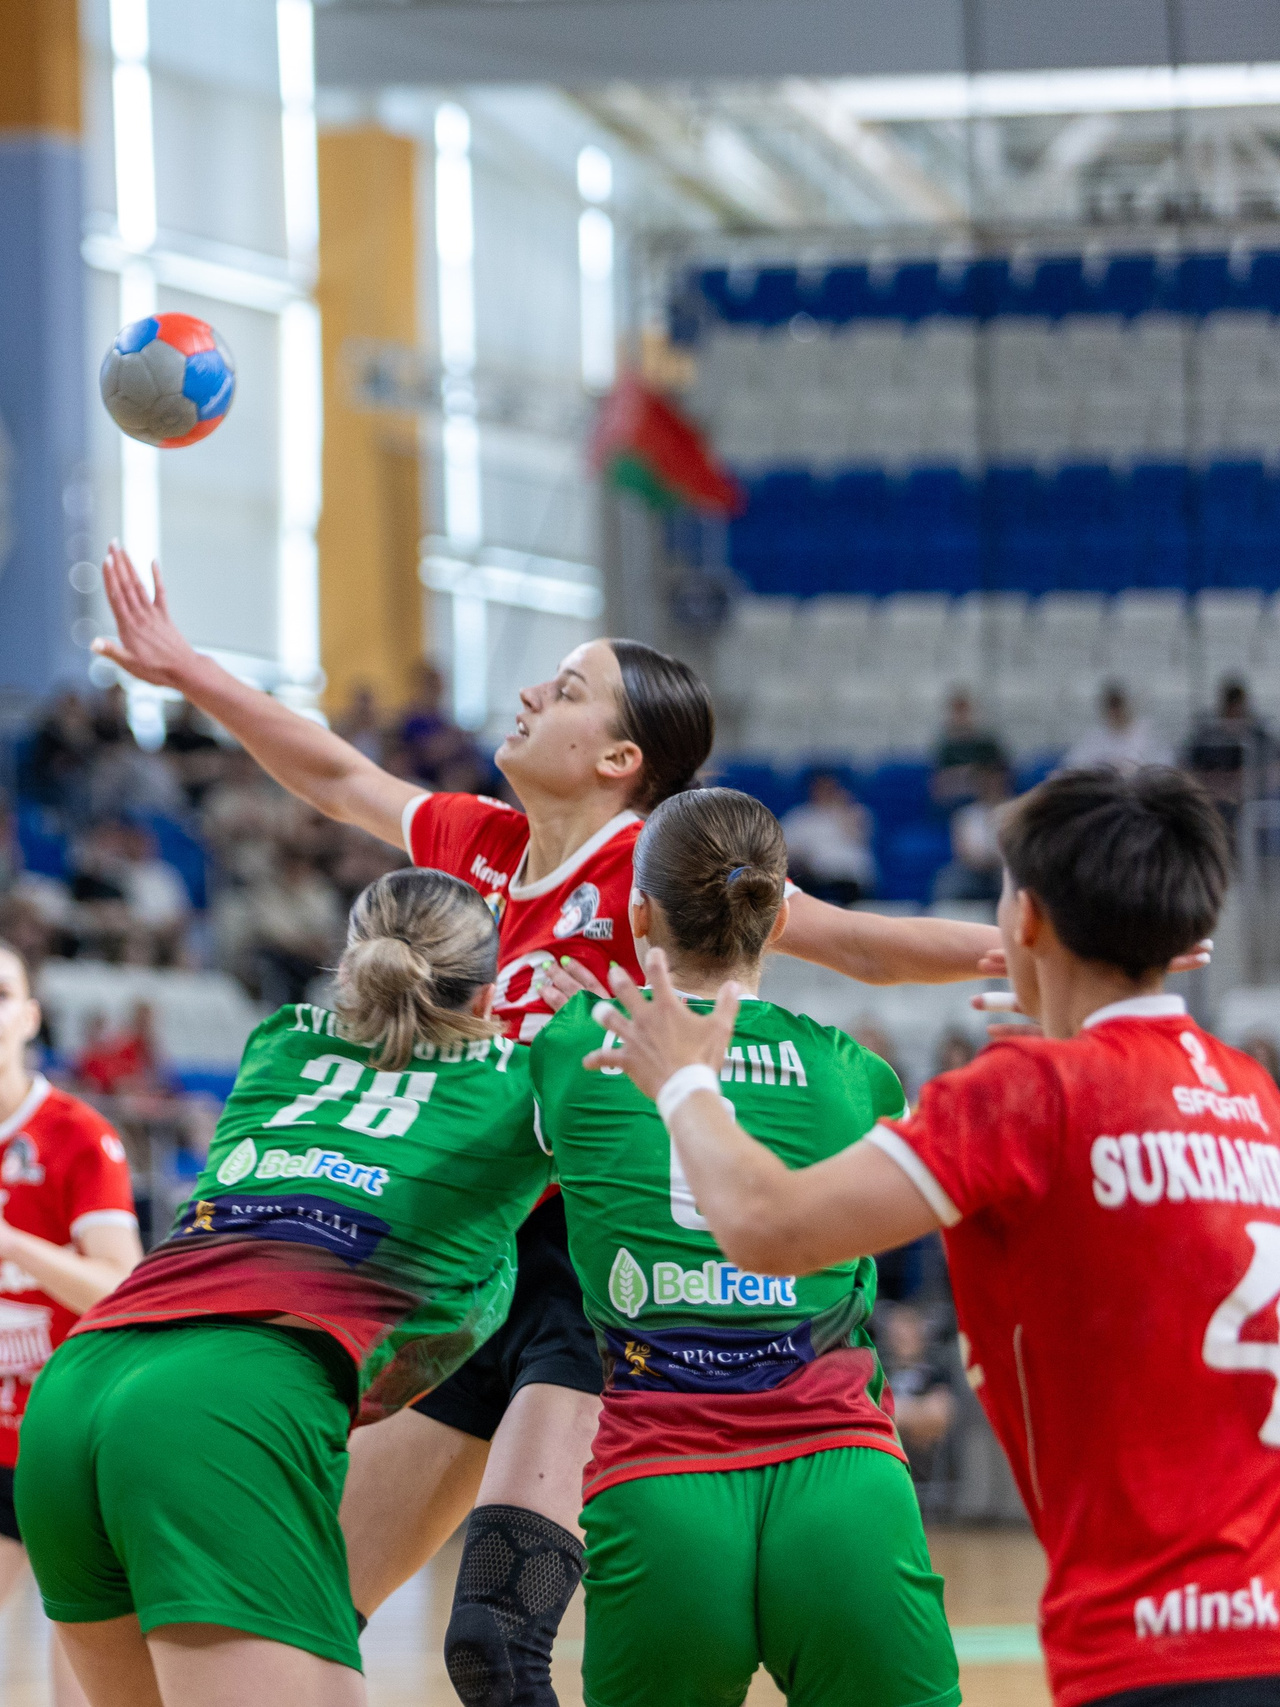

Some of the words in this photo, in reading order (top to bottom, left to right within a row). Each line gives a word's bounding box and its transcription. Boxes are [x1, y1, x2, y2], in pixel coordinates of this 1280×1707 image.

[258, 1150, 388, 1195] BelFert
[655, 1264, 794, 1303] BelFert
[669, 1336, 797, 1364] РИСТЛЛ
[1134, 1576, 1278, 1639] Minsk
